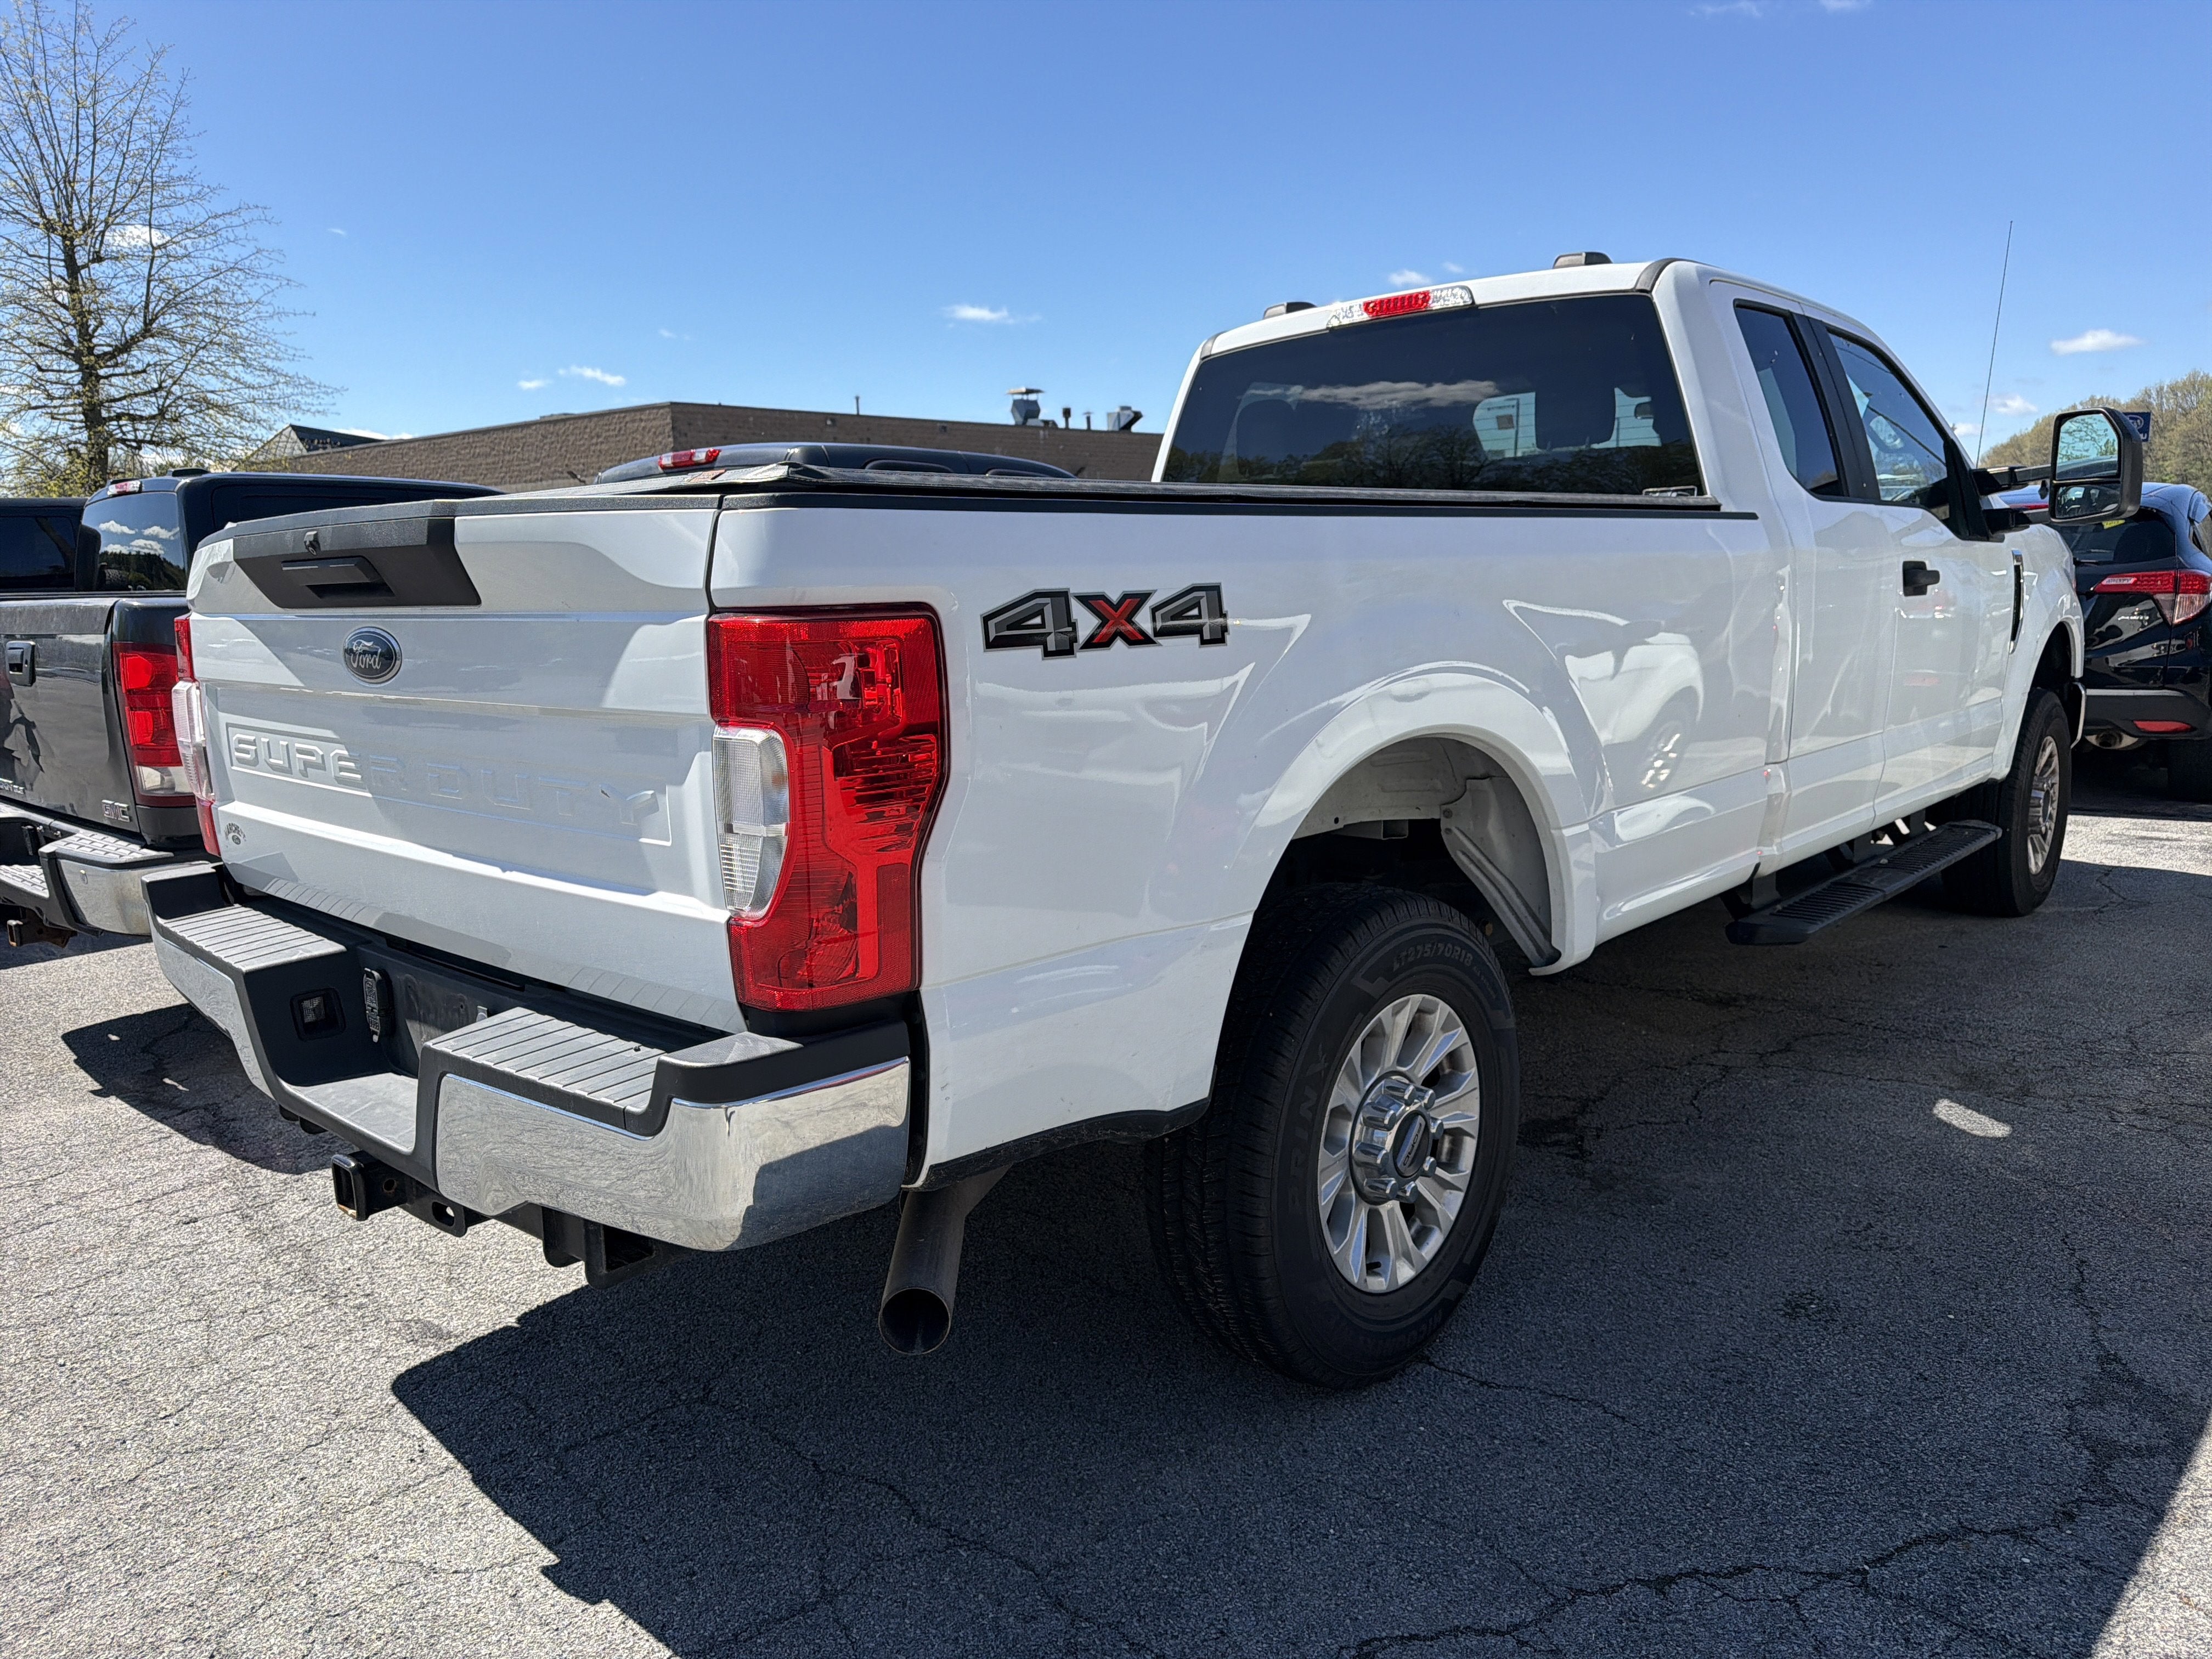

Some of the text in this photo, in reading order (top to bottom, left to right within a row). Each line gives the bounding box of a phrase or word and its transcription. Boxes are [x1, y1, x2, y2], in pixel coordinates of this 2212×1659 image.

[352, 639, 382, 669] Ford
[232, 733, 661, 827] SUPER DUTY
[101, 799, 131, 822] GMC
[1391, 942, 1474, 973] LT275/70R18
[1404, 1123, 1422, 1166] FORD
